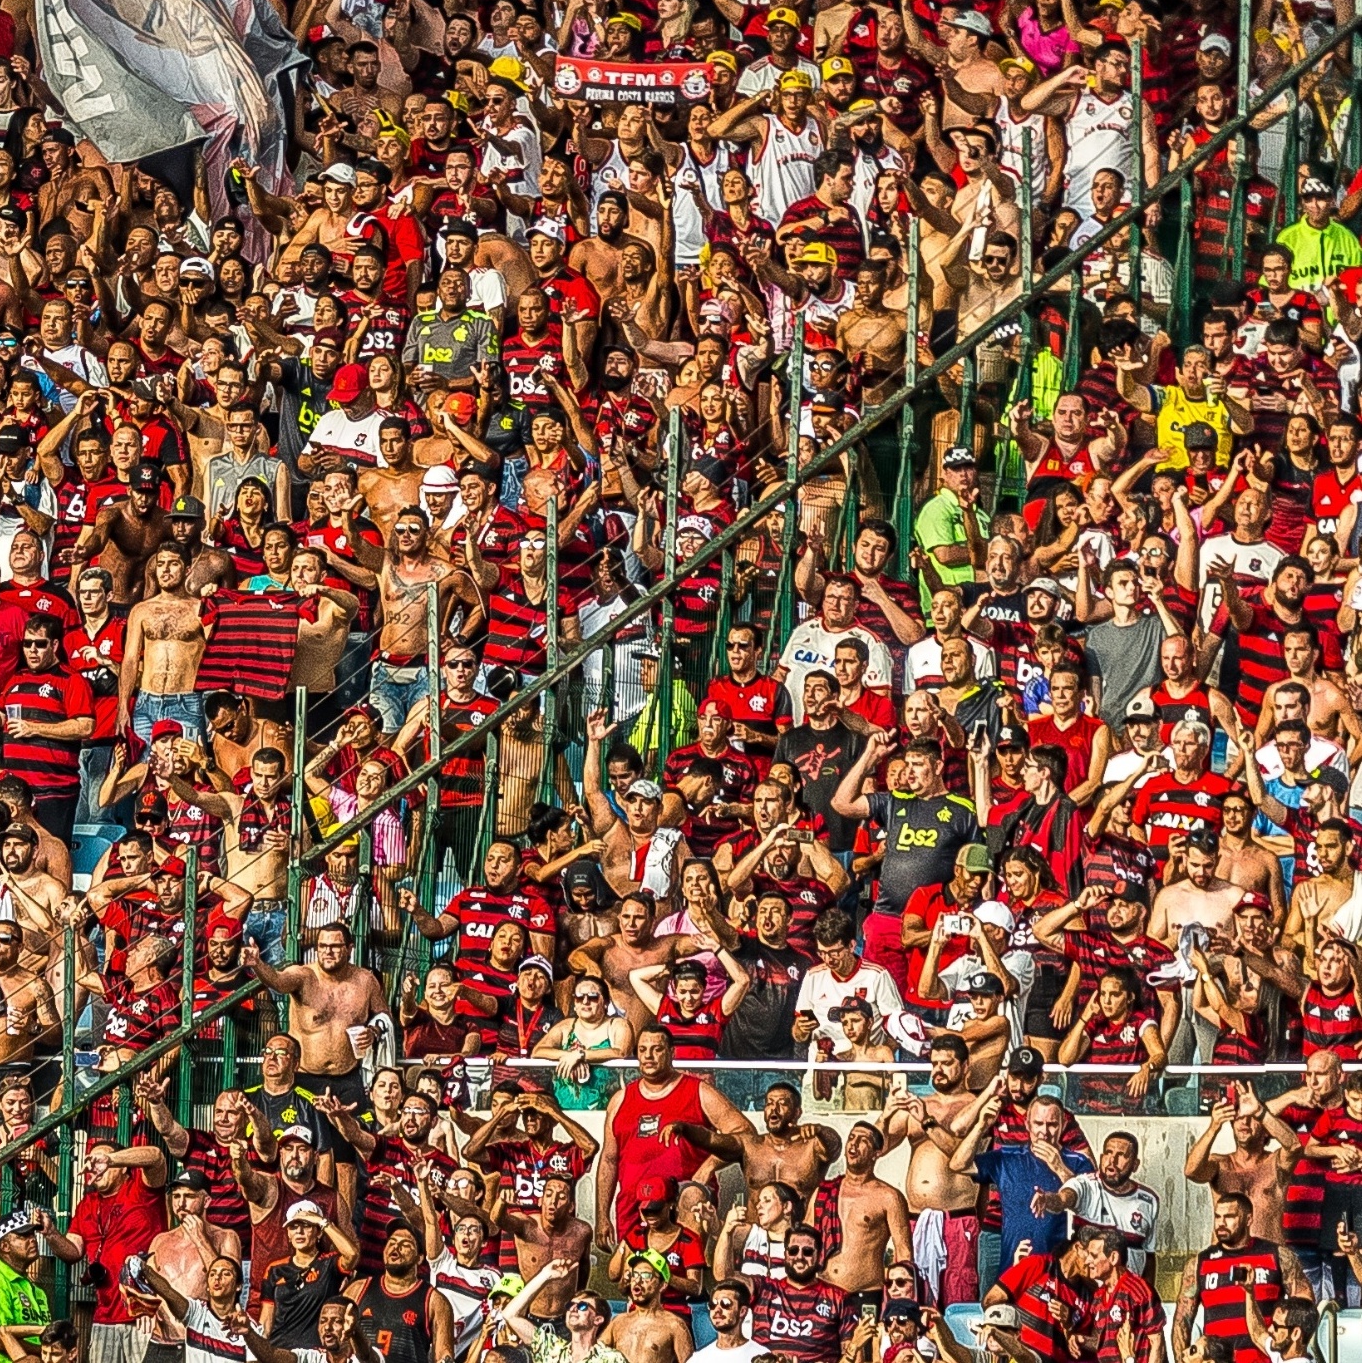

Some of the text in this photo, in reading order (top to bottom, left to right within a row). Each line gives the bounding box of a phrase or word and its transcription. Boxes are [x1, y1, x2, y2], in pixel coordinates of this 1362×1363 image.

[604, 71, 657, 87] TFM
[423, 342, 453, 363] bs2
[897, 823, 938, 847] bs2
[466, 922, 494, 938] CAI
[1205, 1272, 1218, 1290] 10
[770, 1310, 813, 1337] bs2
[376, 1329, 393, 1356] 9
